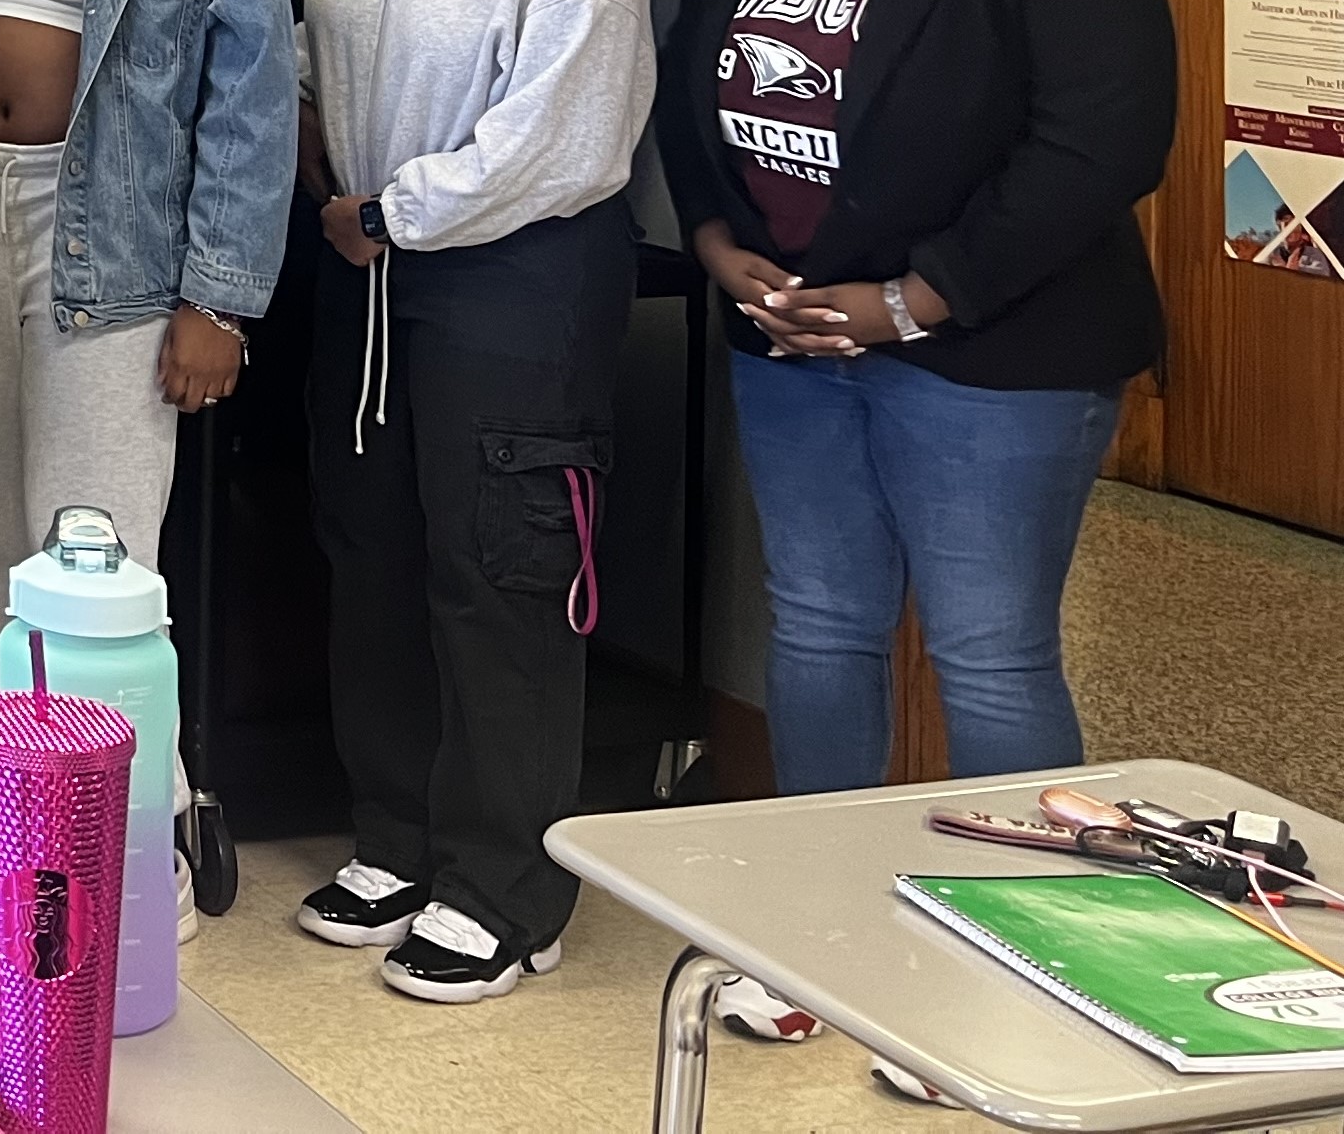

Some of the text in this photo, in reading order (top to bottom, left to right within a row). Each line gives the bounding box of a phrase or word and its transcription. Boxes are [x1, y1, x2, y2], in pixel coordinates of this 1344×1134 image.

[730, 118, 830, 162] NCCU
[753, 154, 832, 187] EAGLES
[1252, 1003, 1320, 1019] 70
